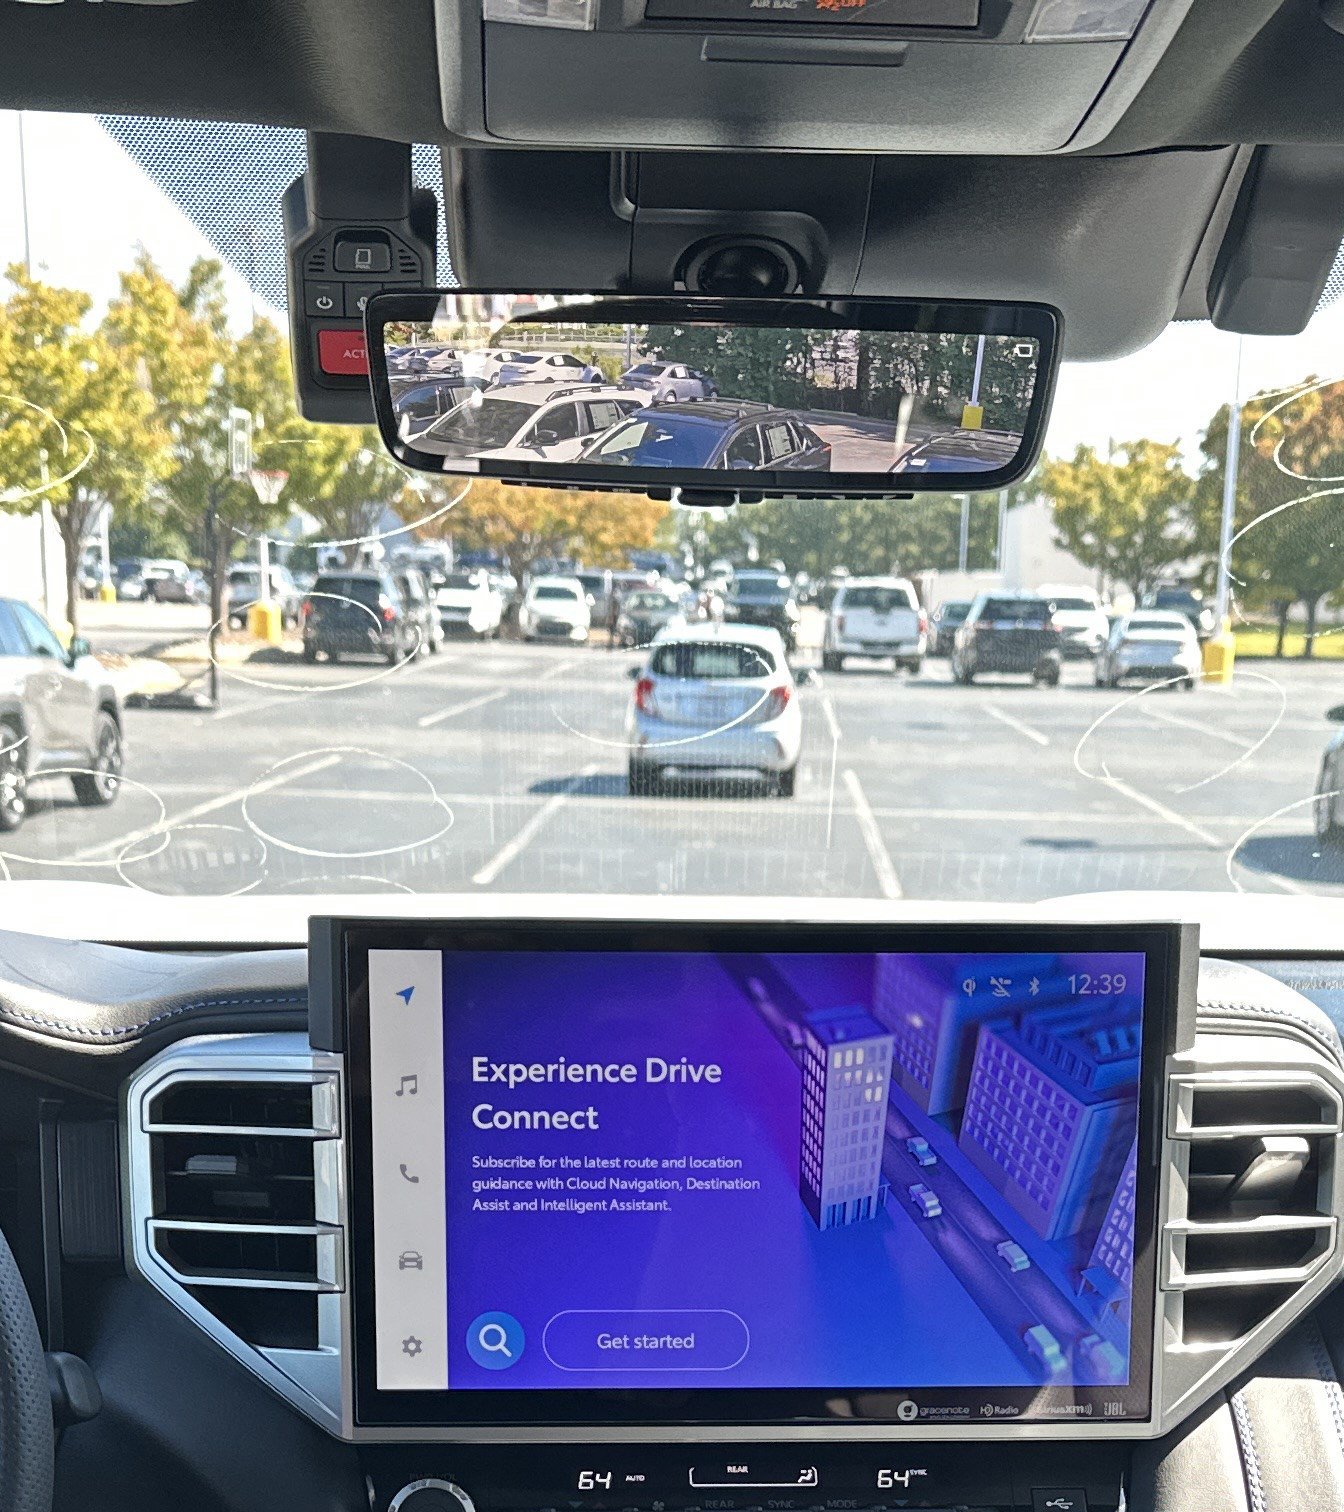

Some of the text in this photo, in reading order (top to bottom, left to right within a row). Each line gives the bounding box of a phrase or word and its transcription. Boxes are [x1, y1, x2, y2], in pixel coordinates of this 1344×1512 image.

[1067, 974, 1127, 995] 12:39
[472, 1056, 722, 1089] Experience Drive
[471, 1103, 600, 1130] Connect
[472, 1155, 743, 1169] Subscribe for the latest route and location
[472, 1178, 761, 1193] guidance with Cloud Navigation, Destination
[472, 1200, 672, 1214] Assist and Intelligent Assistant.
[597, 1332, 695, 1349] Get started
[919, 1407, 971, 1416] gracenote
[994, 1405, 1019, 1415] Radio
[1103, 1402, 1127, 1417] JBL
[727, 1465, 748, 1474] REAR
[577, 1471, 645, 1490] 64 AUTO
[877, 1469, 910, 1488] 64
[706, 1500, 735, 1510] REAR
[768, 1499, 794, 1510] SYNC
[826, 1499, 857, 1510] MODE
